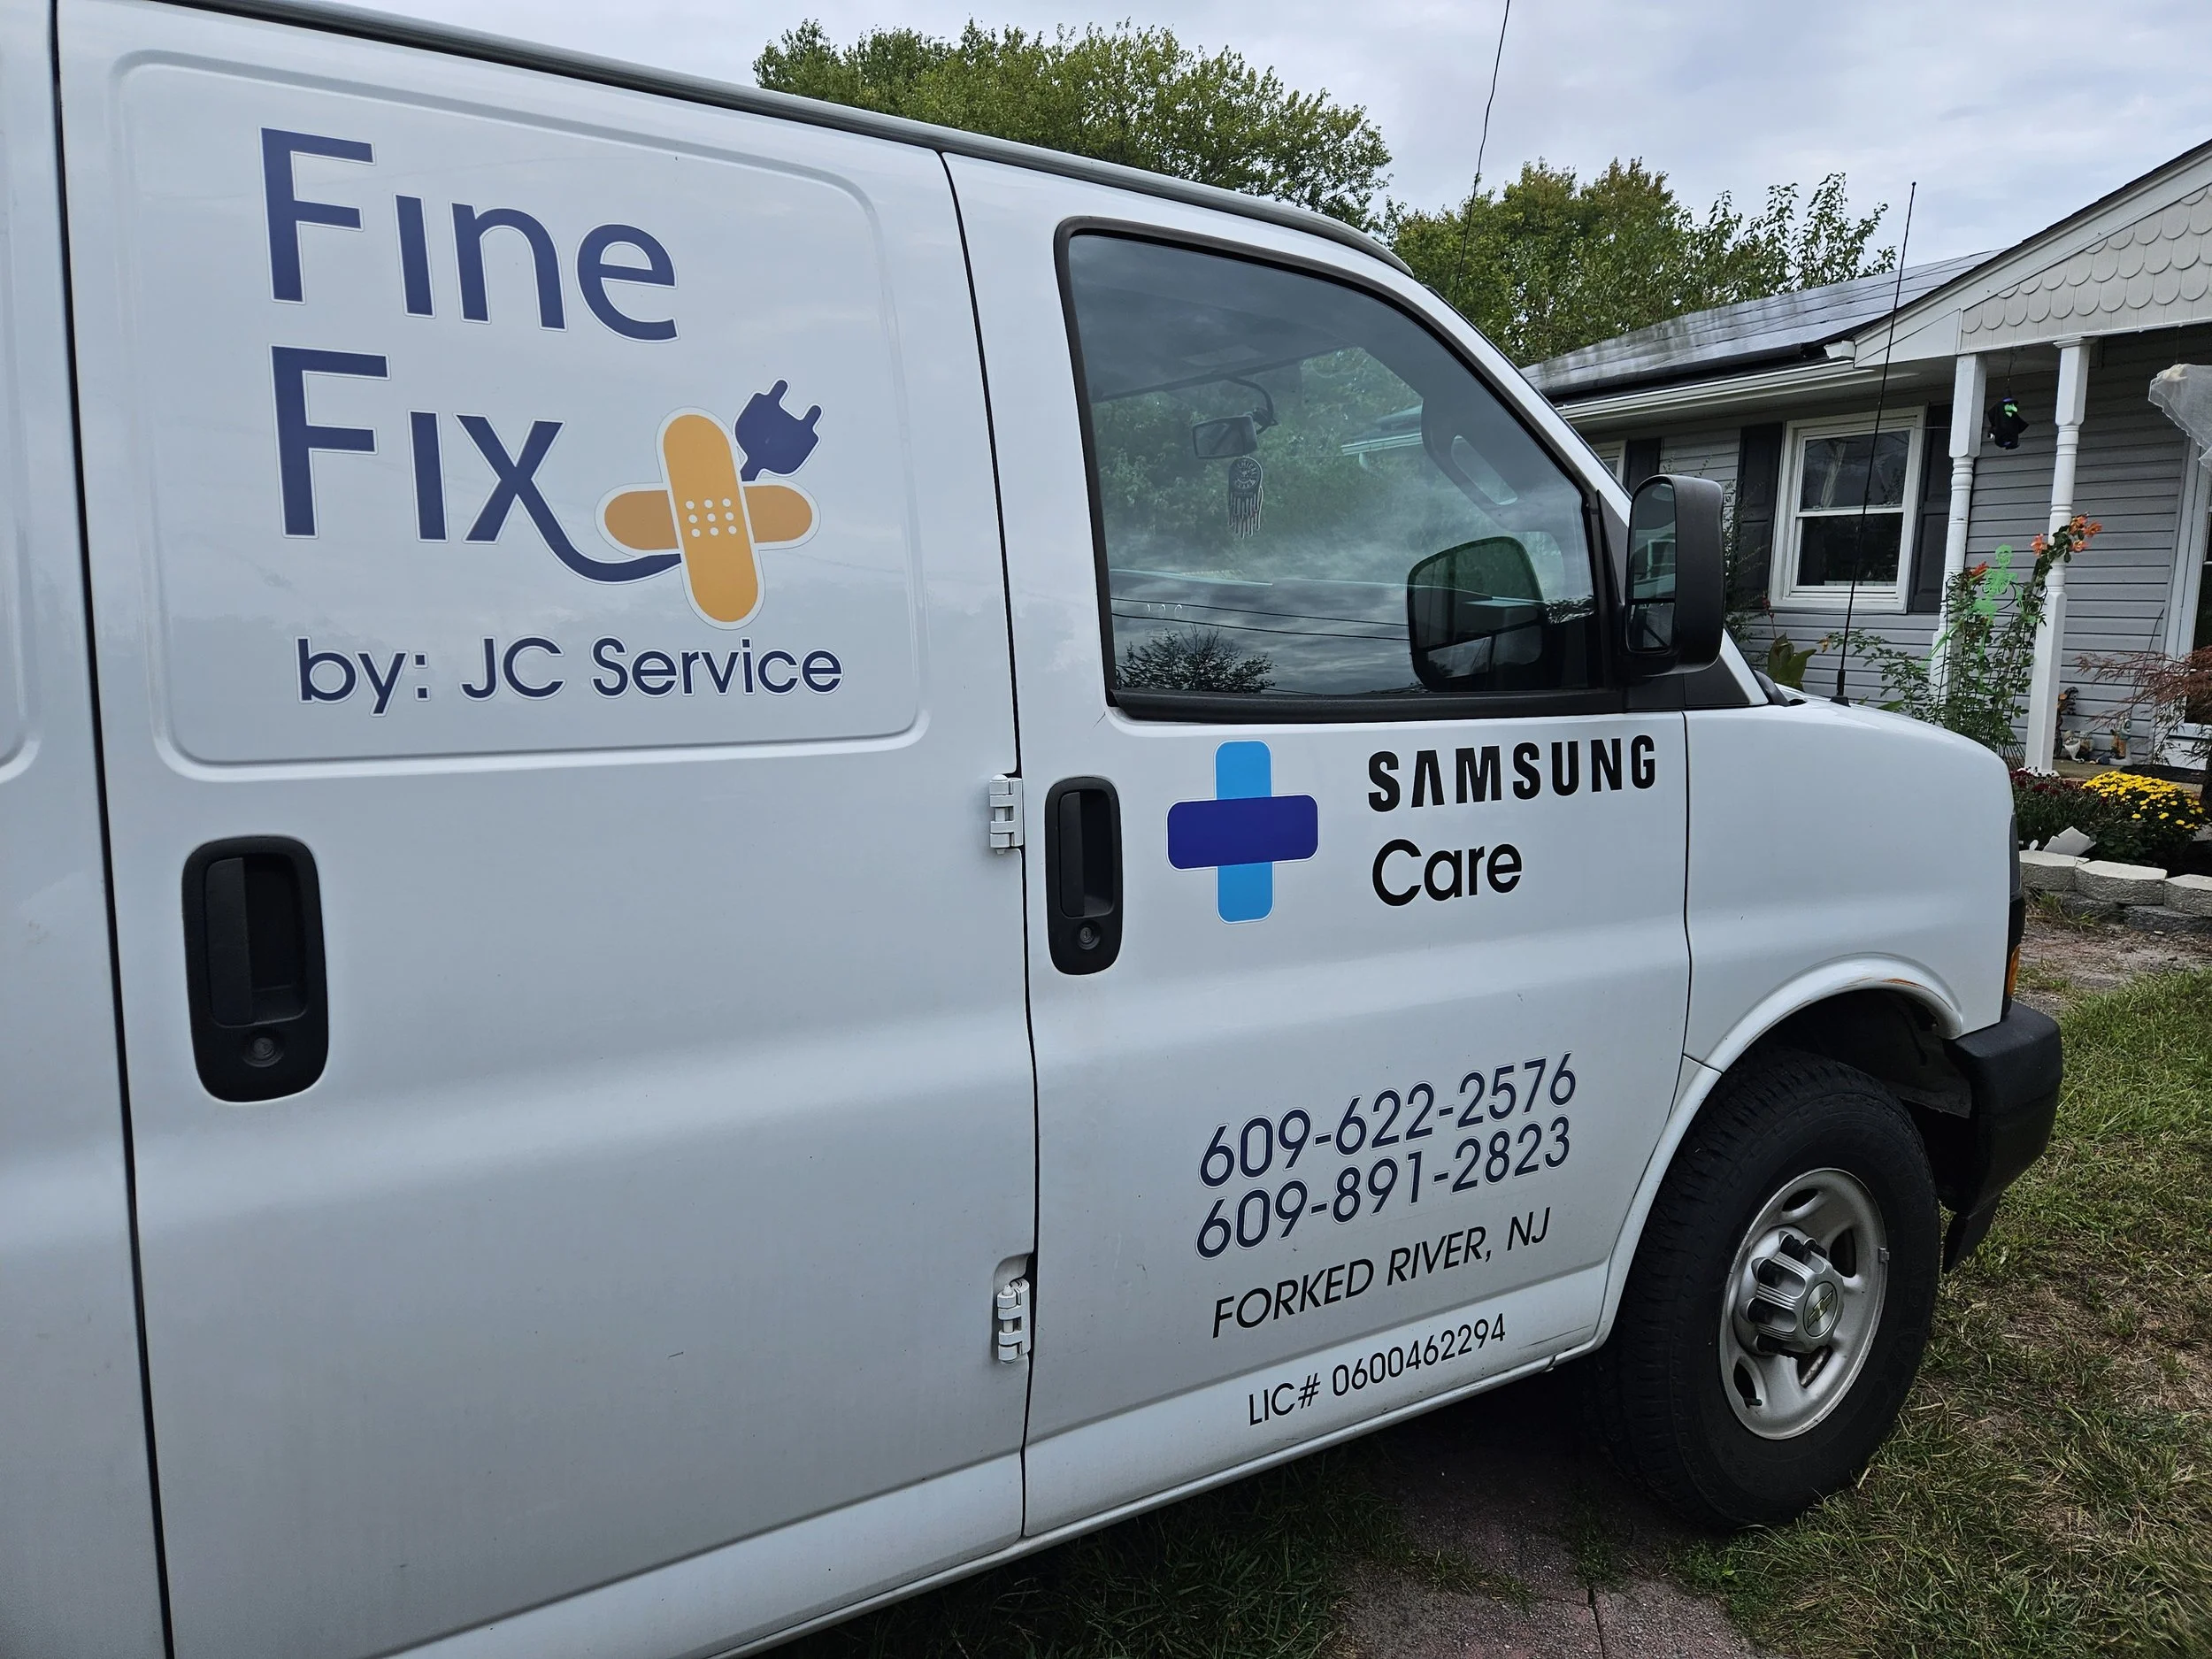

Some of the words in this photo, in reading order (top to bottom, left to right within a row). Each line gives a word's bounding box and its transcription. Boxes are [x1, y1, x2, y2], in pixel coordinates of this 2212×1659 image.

[260, 127, 678, 341] Fine
[271, 345, 682, 583] Fix
[297, 638, 428, 715] by:
[461, 637, 564, 699] JC
[593, 637, 842, 696] Service
[1368, 734, 1655, 813] SAMSUNG
[1371, 838, 1523, 907] Care
[1200, 1052, 1577, 1187] 609-622-2576
[1196, 1116, 1570, 1258] 609-891-2823
[1212, 1258, 1374, 1339] FORKED
[1386, 1225, 1492, 1286] RIVER,
[1507, 1206, 1551, 1251] NJ
[1248, 1372, 1321, 1426] LIC#
[1332, 1312, 1506, 1397] 0600462294
